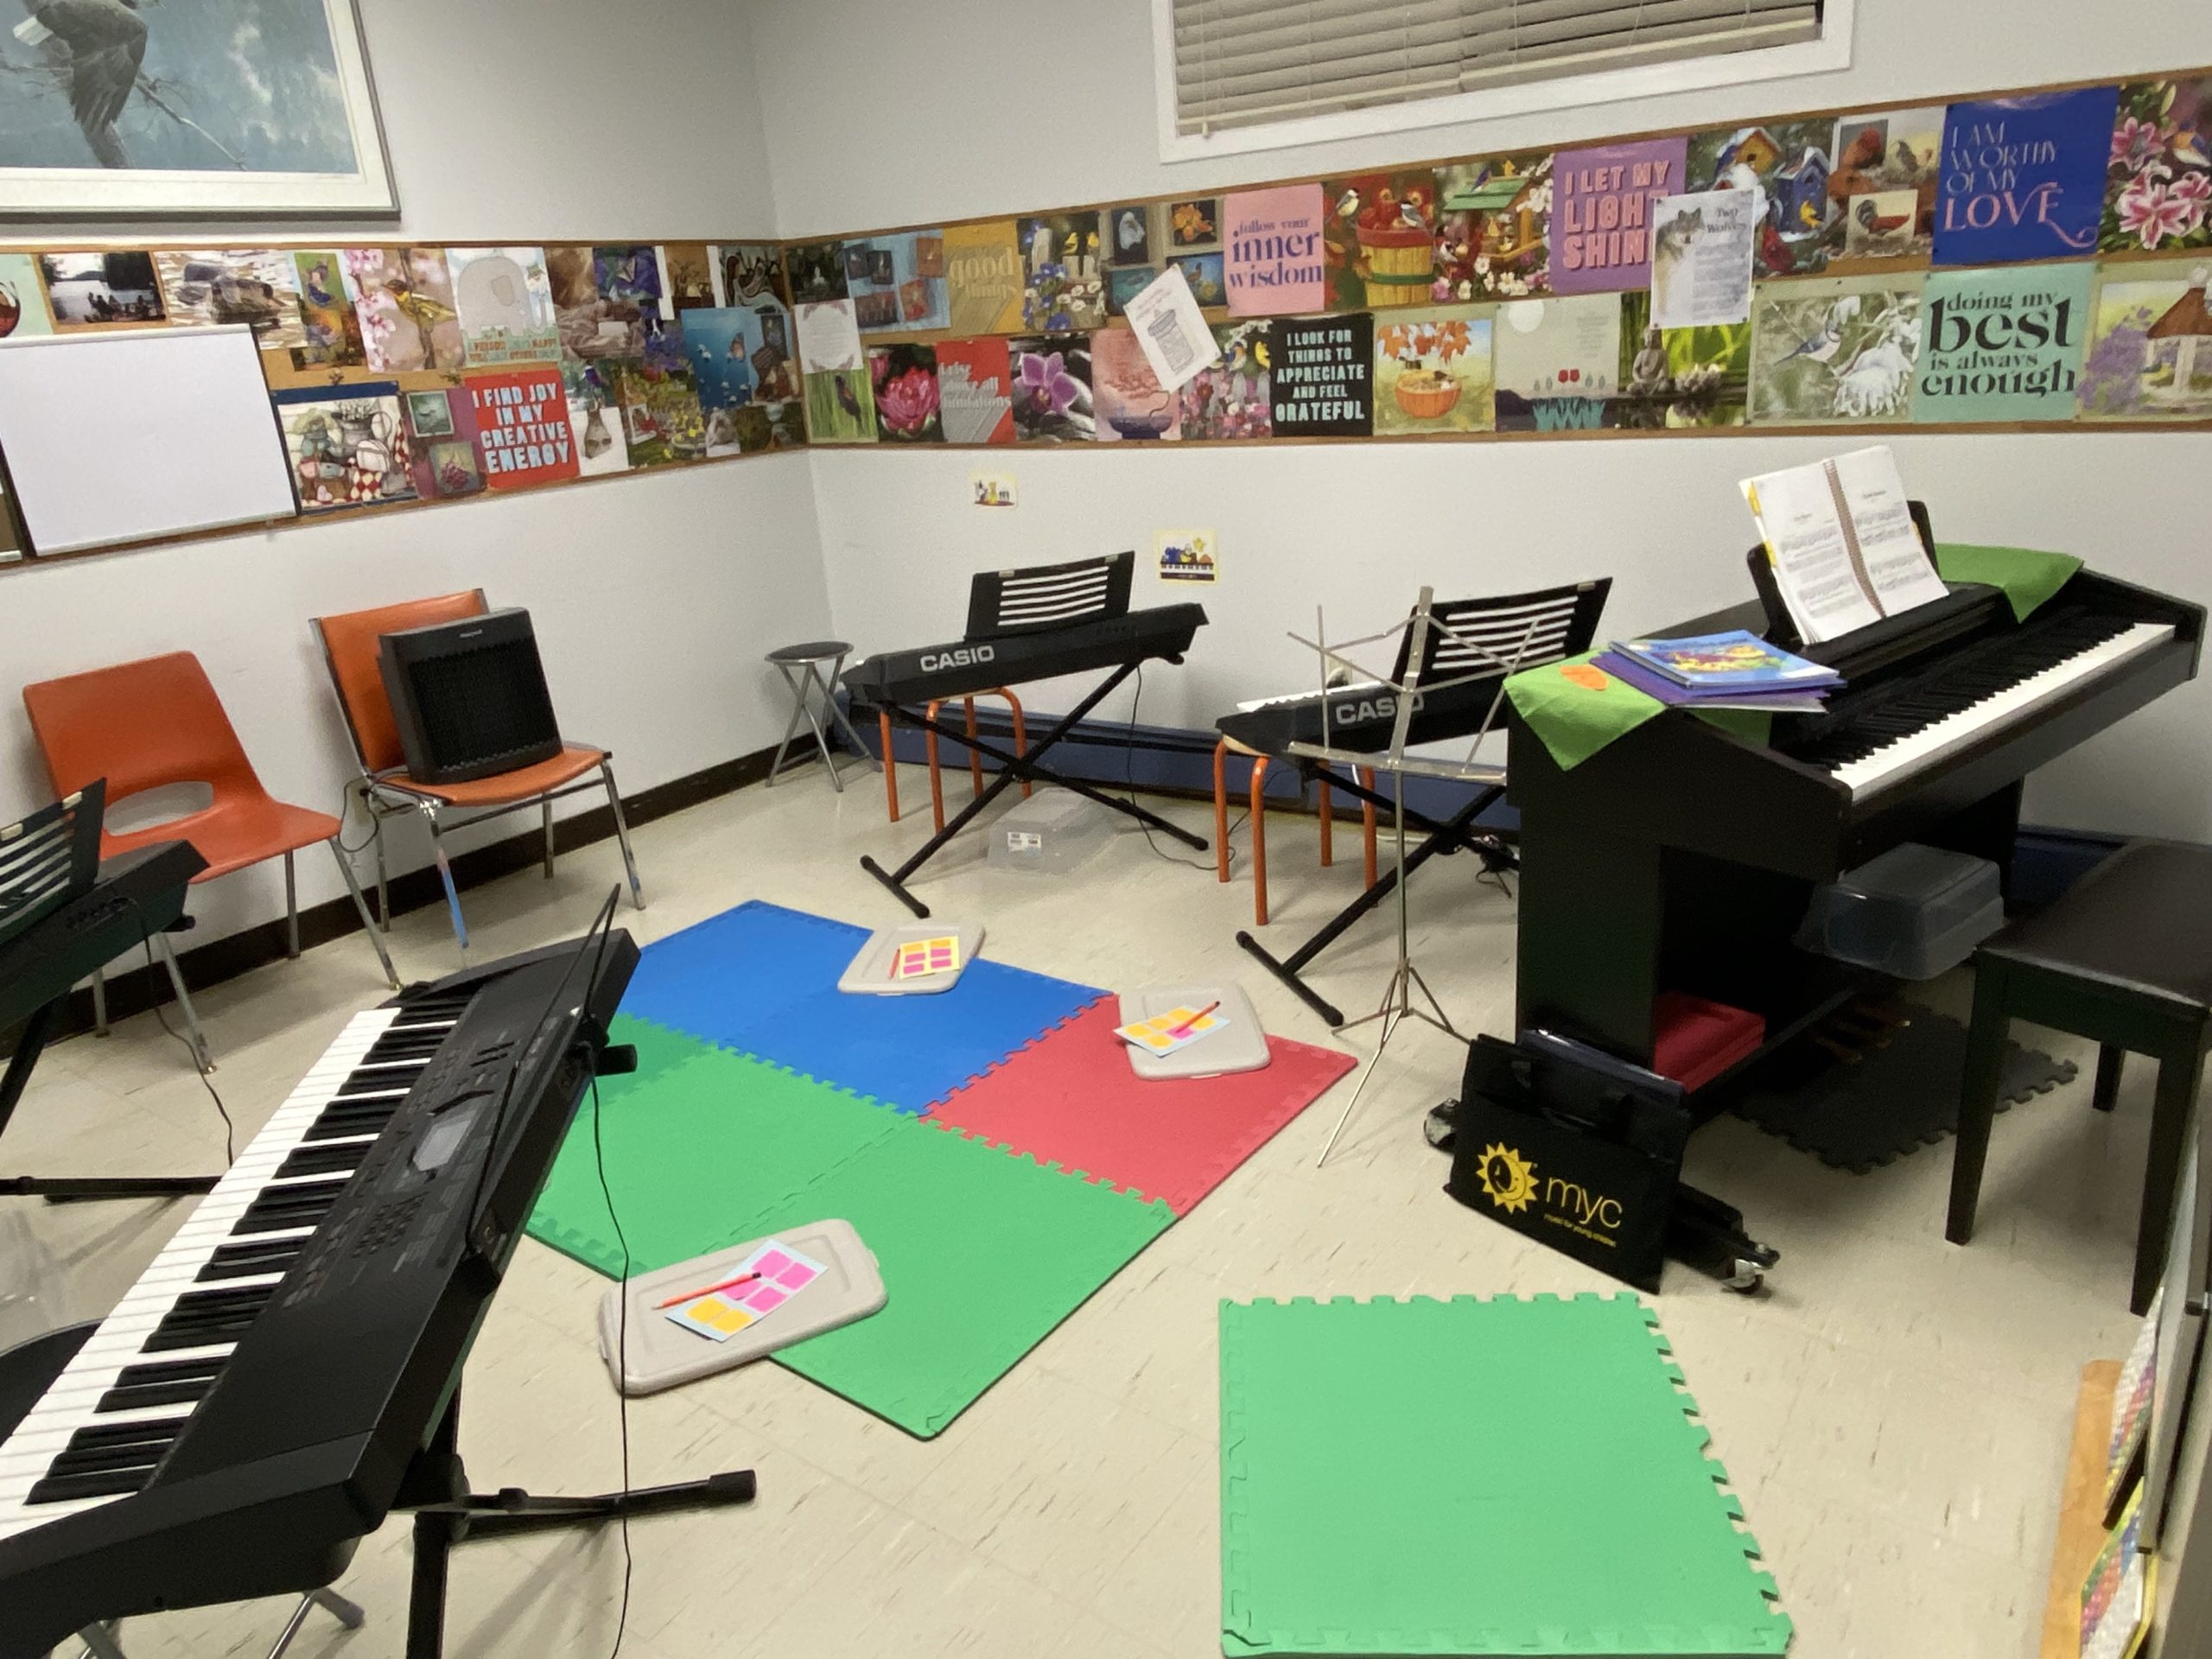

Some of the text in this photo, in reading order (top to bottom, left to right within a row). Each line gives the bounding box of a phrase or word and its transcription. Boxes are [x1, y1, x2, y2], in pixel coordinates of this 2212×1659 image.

[1967, 121, 2005, 147] AM
[1950, 140, 2056, 171] WORTHY
[1565, 160, 1671, 195] I LET MY
[1563, 189, 1669, 235] LIGH
[1943, 181, 2099, 249] LOVE
[1233, 231, 1320, 263] inner
[1563, 228, 1655, 270] SHIN
[950, 246, 1014, 289] good
[1230, 261, 1322, 288] wisdom
[1947, 290, 2058, 311] doing my
[1287, 329, 1352, 346] I LOOK FOR
[1929, 296, 2075, 353] best
[1287, 346, 1353, 364] THINGS TO
[1930, 350, 2038, 371] is always
[1276, 364, 1365, 384] APPRECIATE
[1921, 359, 2075, 397] enough
[472, 382, 557, 409] I FIND JOY
[1293, 384, 1348, 400] AND FEEL
[495, 404, 543, 426] IN MY
[1275, 400, 1365, 423] GRATEFUL
[480, 421, 569, 448] CREATIVE
[485, 442, 569, 474] ENERGY
[920, 645, 995, 672] CASIO
[1336, 691, 1425, 725] CASO
[1547, 1177, 1623, 1229] myc
